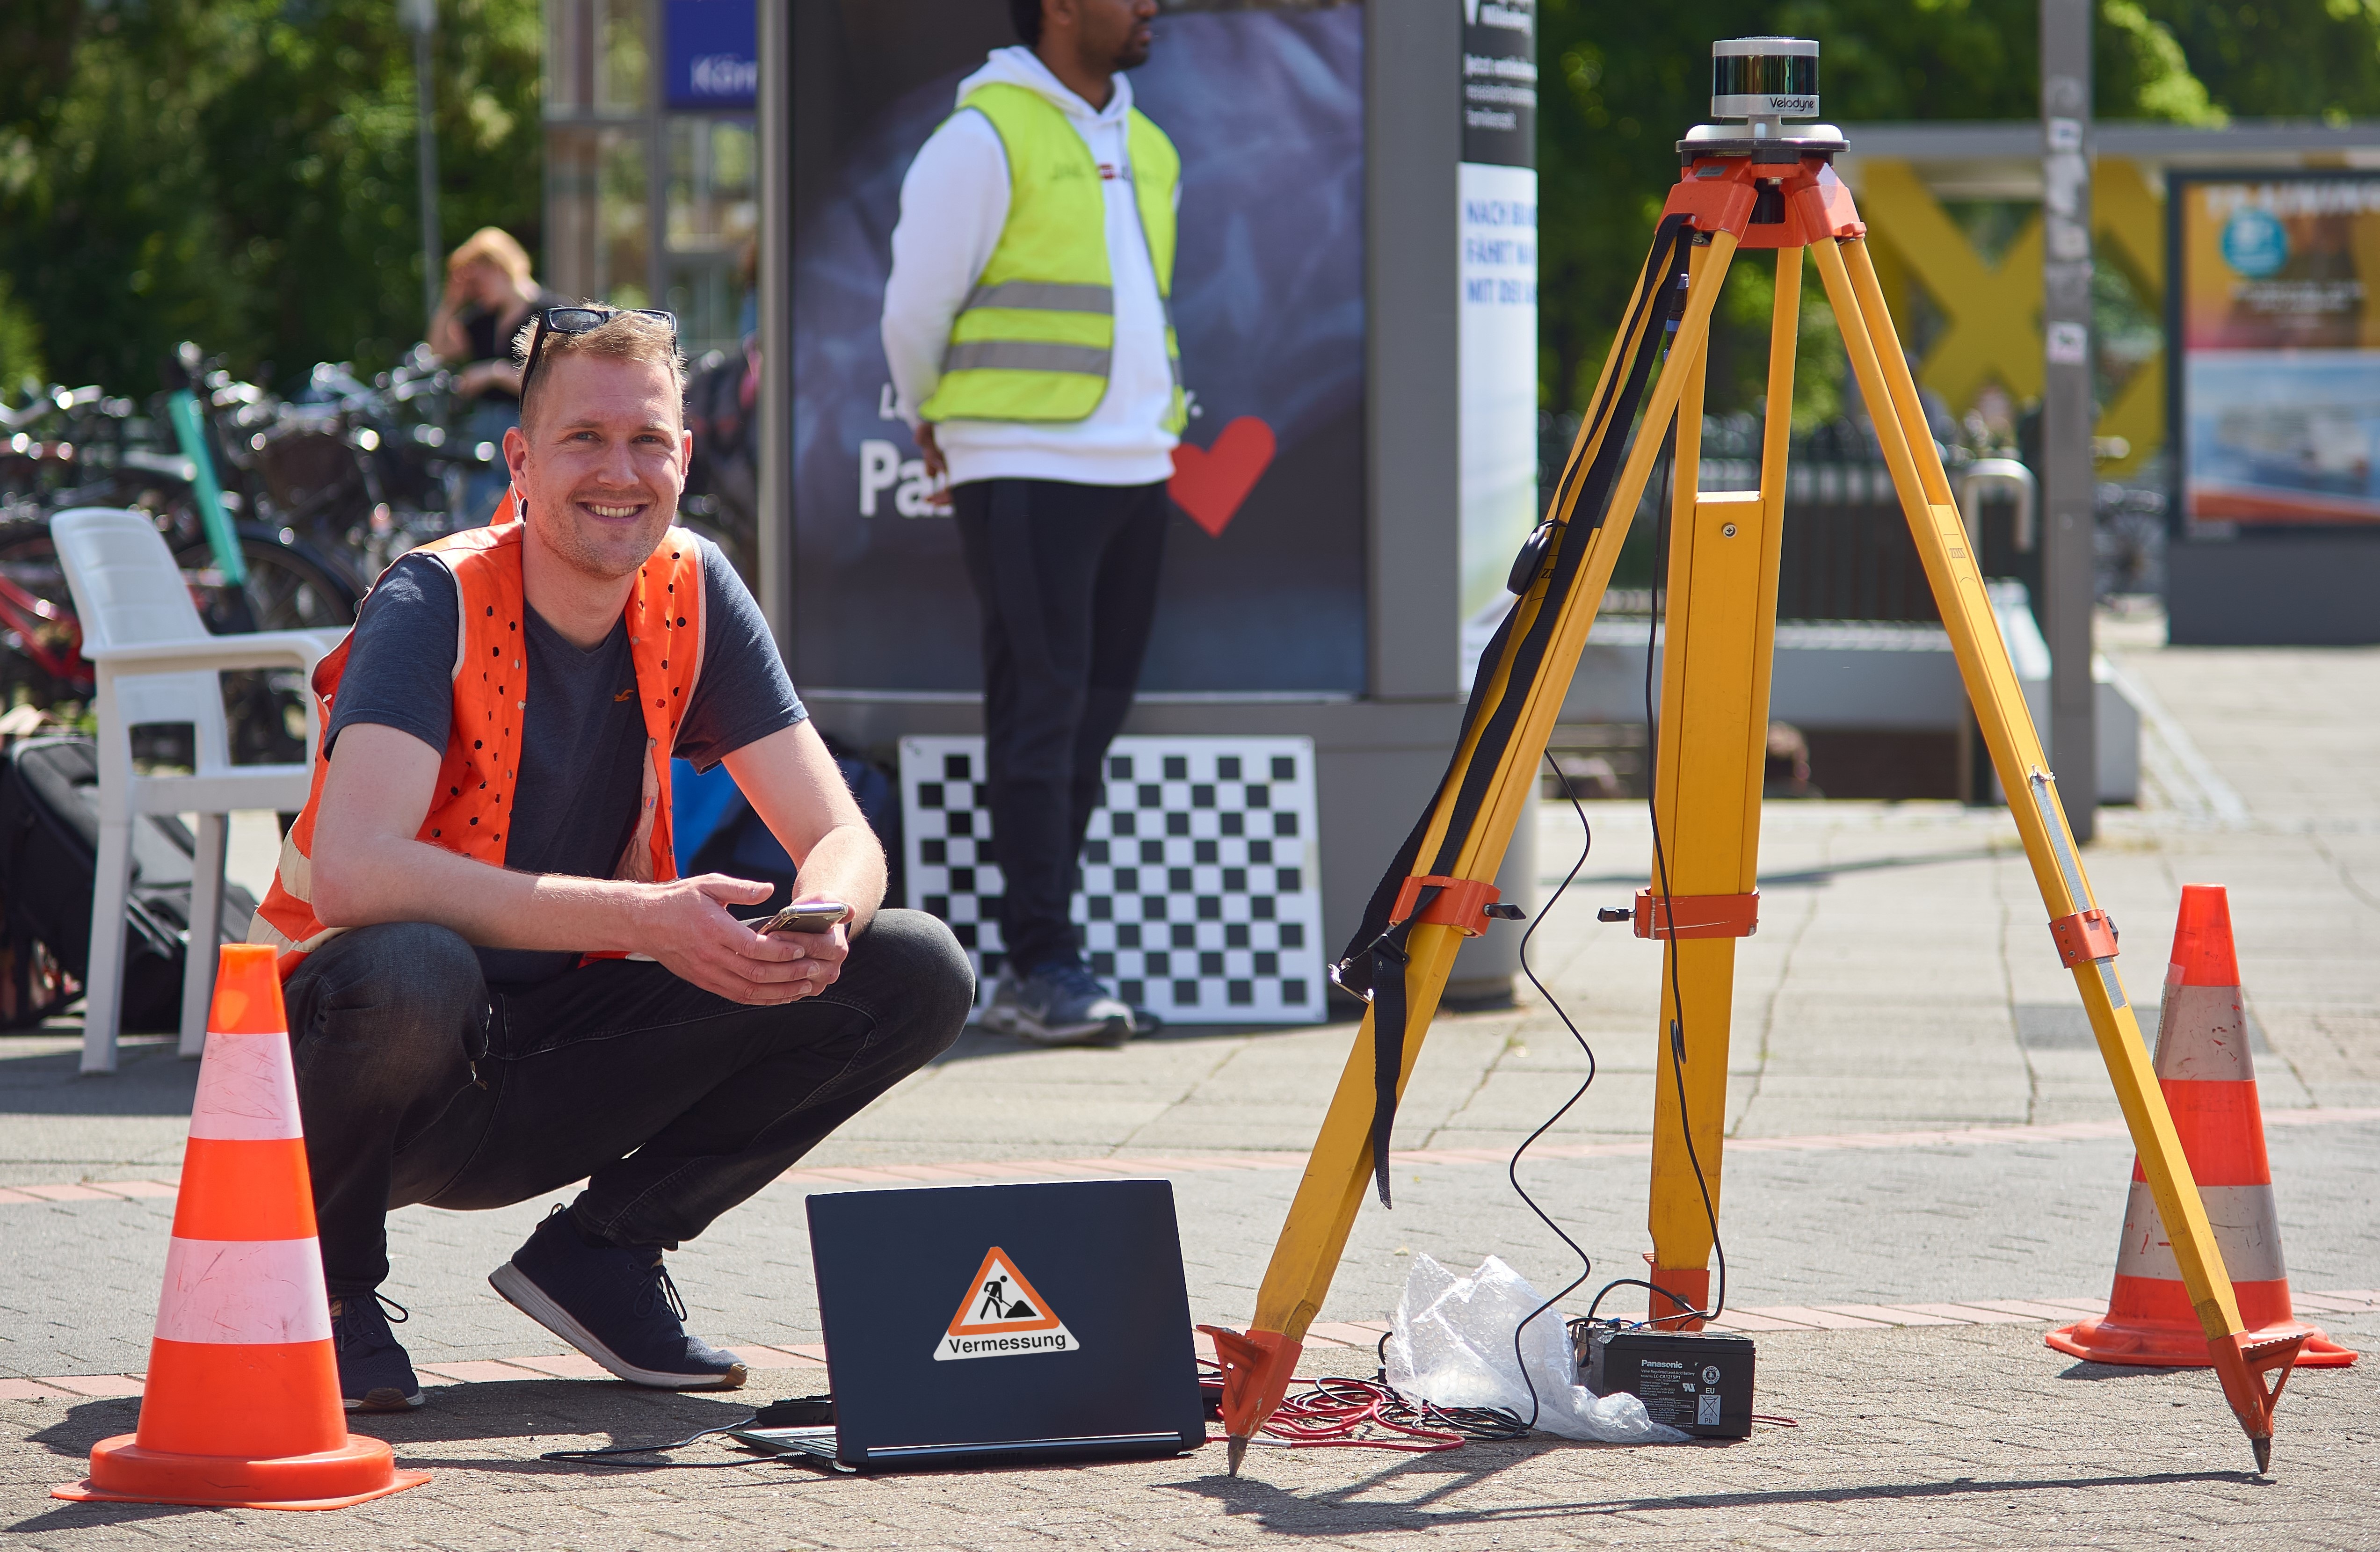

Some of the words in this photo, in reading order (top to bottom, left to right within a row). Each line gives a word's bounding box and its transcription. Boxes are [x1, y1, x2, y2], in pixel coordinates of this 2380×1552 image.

[1770, 97, 1814, 111] Velodyne
[860, 439, 954, 518] Pa
[1949, 548, 1966, 558] ZEISS
[949, 1334, 1066, 1353] Vermessung
[1641, 1359, 1683, 1369] Panasonic
